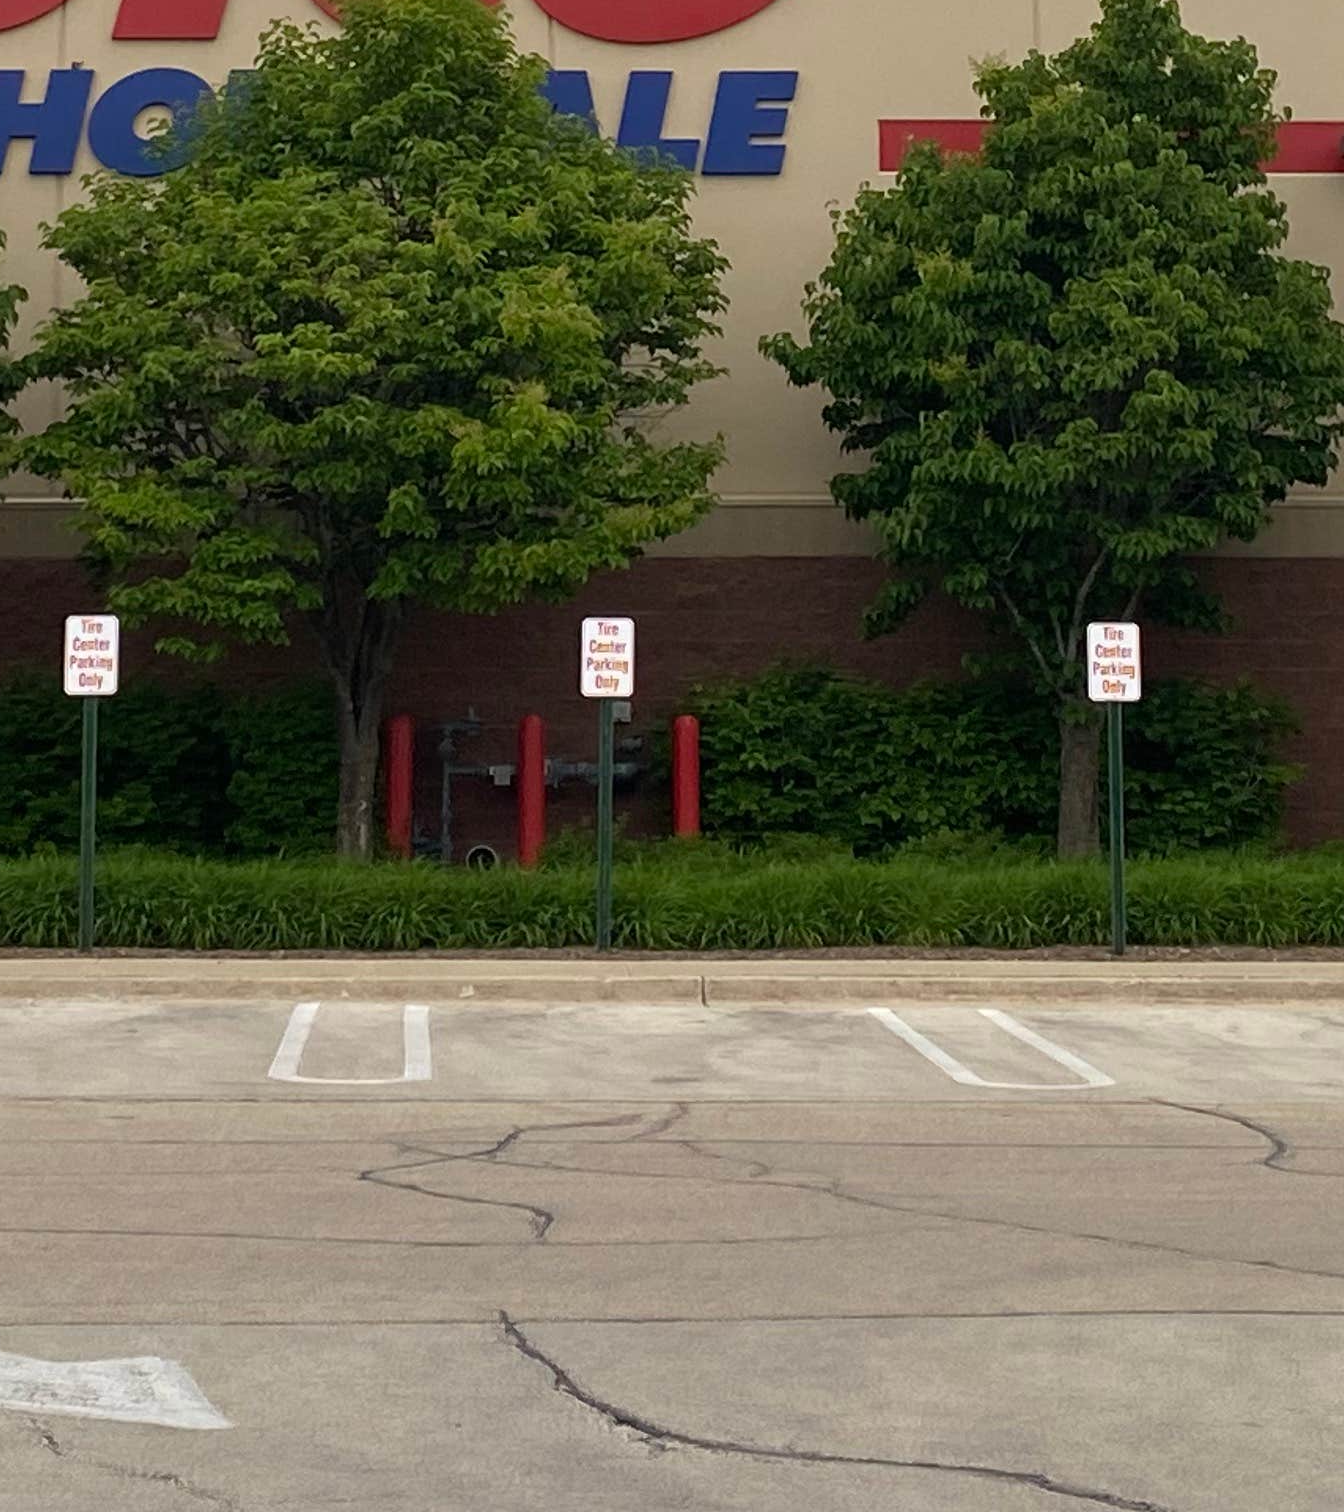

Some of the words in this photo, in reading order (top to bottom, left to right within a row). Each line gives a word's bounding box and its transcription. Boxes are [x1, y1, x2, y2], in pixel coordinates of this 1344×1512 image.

[81, 619, 103, 634] Tire
[598, 621, 619, 636] Tire
[1103, 627, 1124, 641] Tire
[72, 636, 110, 651] Center
[589, 639, 626, 653] Center
[1095, 644, 1132, 658] Center
[69, 655, 113, 671] Parking
[587, 657, 629, 673] Parking
[1093, 661, 1135, 679] Parking
[79, 672, 103, 689] Only
[595, 674, 619, 691] Only
[1102, 679, 1127, 696] Only
